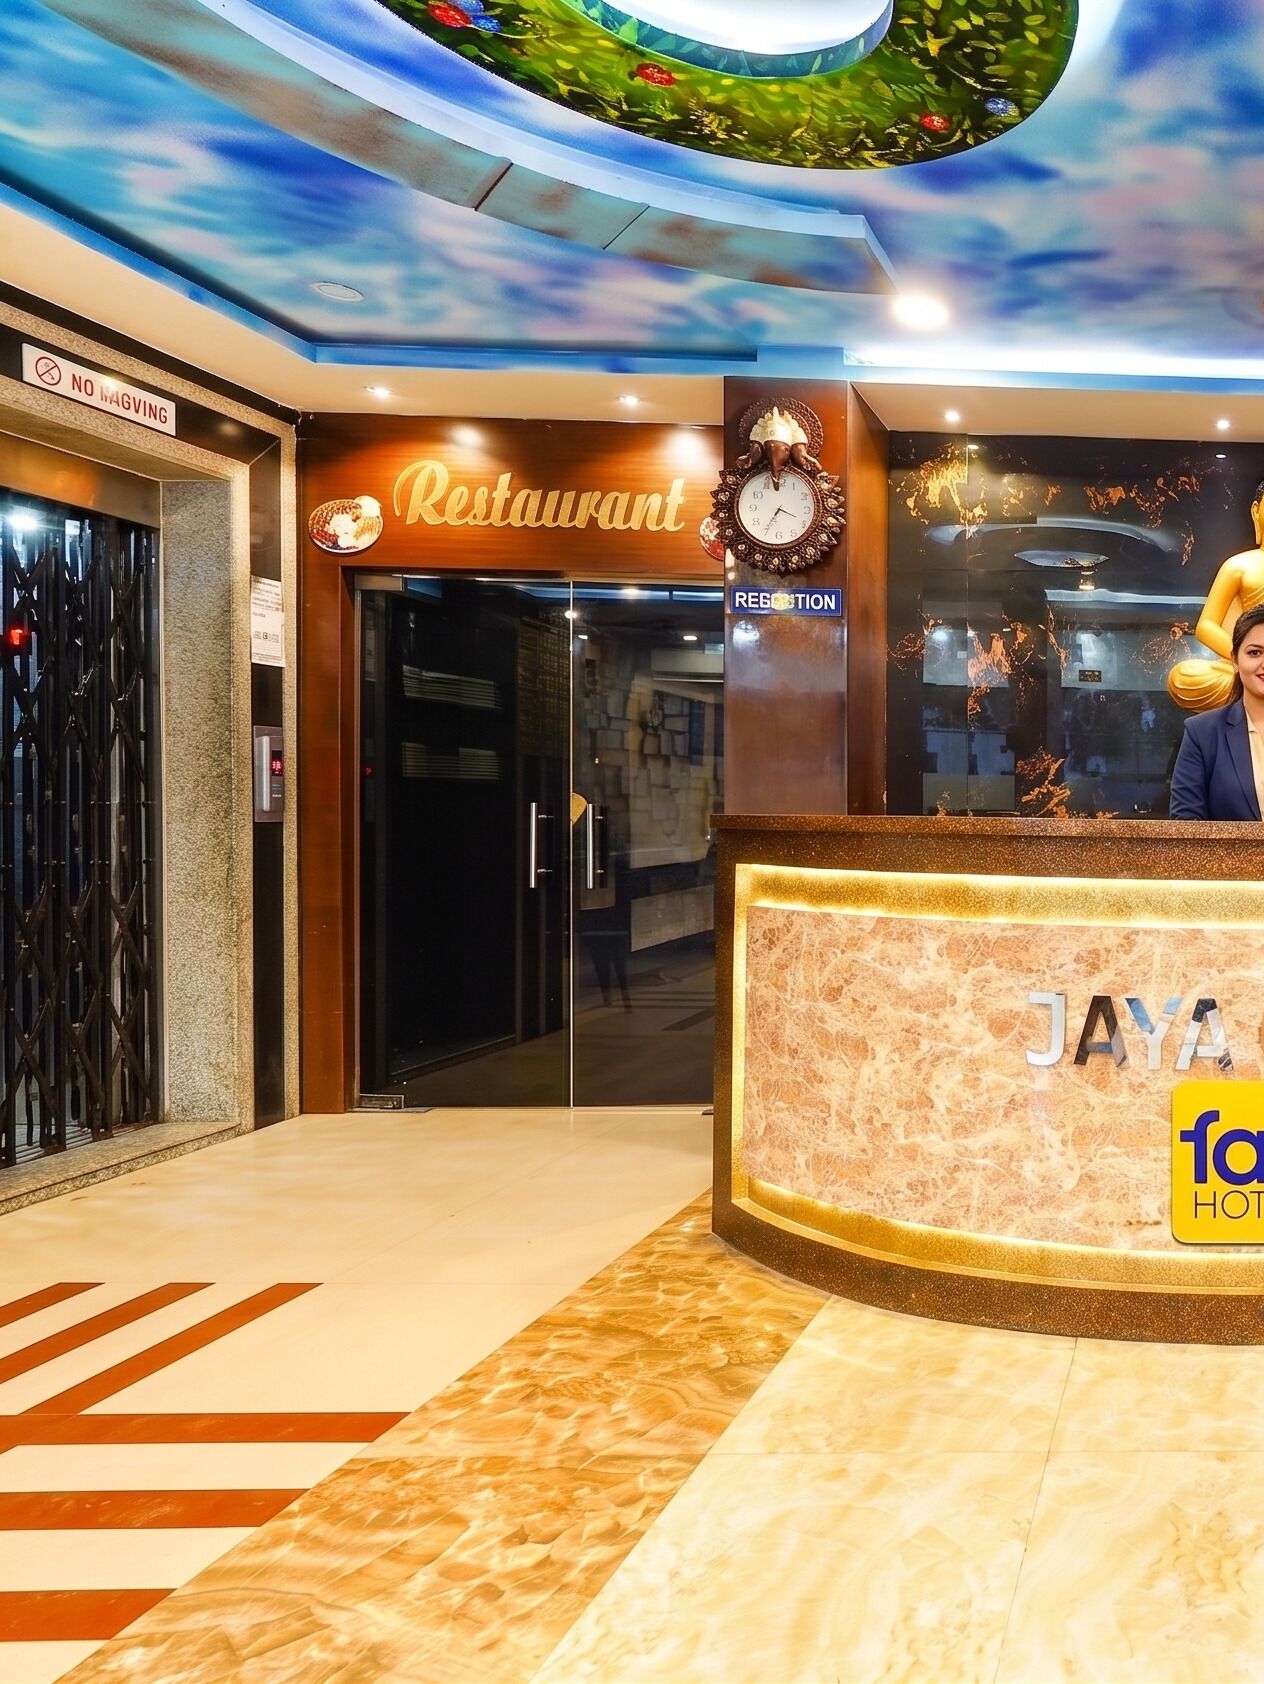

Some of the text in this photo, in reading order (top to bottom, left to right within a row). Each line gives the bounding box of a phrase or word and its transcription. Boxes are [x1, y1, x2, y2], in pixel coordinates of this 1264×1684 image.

[71, 372, 95, 397] NO
[393, 459, 687, 532] Restaurant
[735, 591, 836, 610] RETION
[1025, 991, 1235, 1072] JAYA
